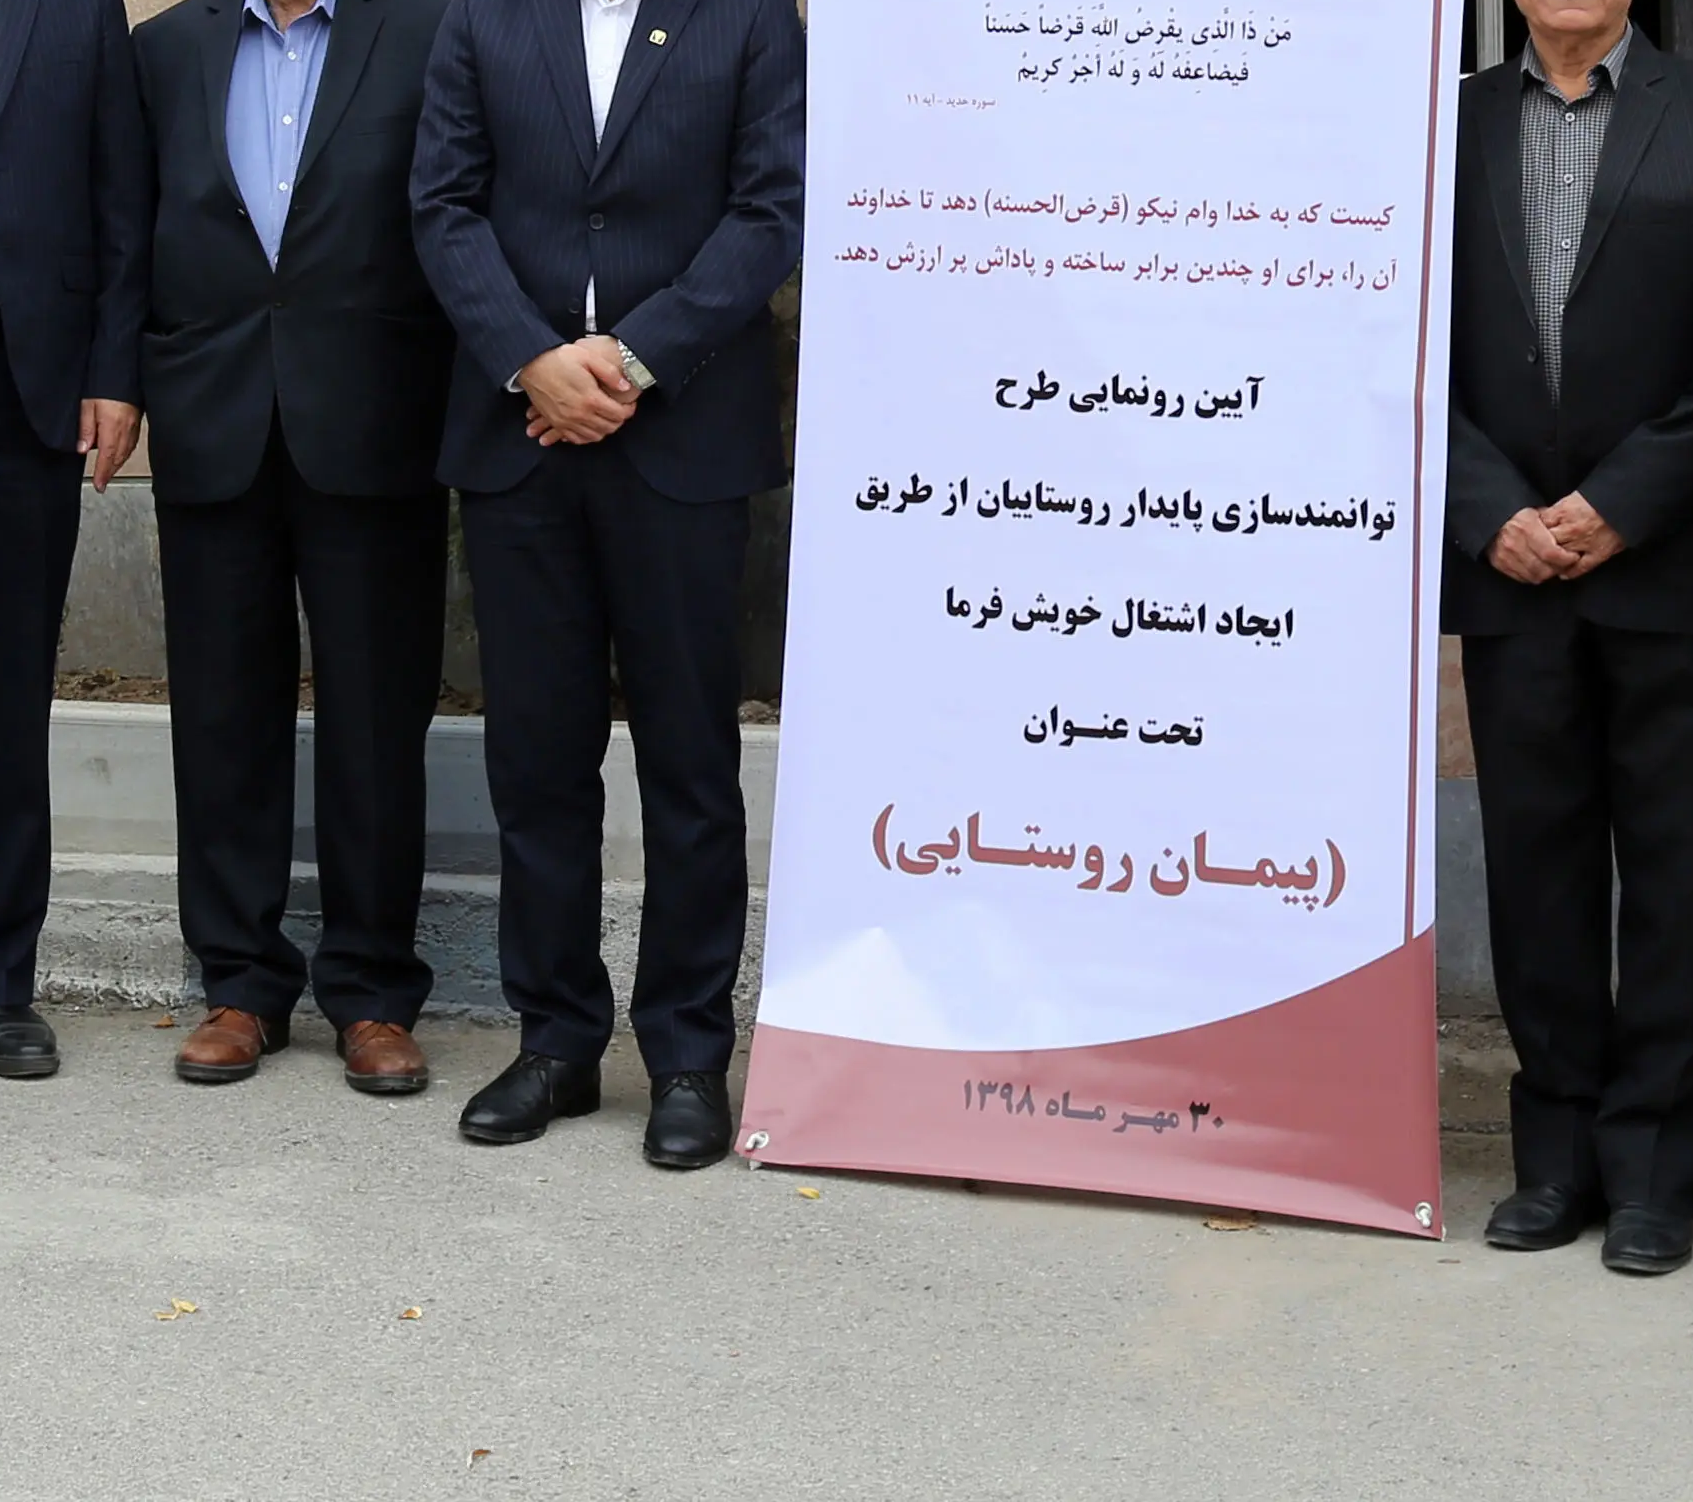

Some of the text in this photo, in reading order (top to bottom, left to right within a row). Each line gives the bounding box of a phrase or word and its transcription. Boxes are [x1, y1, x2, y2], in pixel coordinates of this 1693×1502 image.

[847, 188, 912, 215] خداوند
[919, 189, 935, 209] تا
[941, 194, 978, 212] دهد
[1136, 197, 1178, 225] نیکو
[1226, 199, 1261, 222] خدا
[1297, 202, 1323, 224] که
[1185, 199, 1219, 228] وام
[1269, 211, 1290, 229] به
[1329, 204, 1396, 231] کیست
[833, 245, 880, 263] دهد.
[885, 241, 943, 272] ارزش
[947, 253, 968, 274] پر
[974, 245, 1037, 277] پاداش
[1043, 258, 1056, 278] و
[1062, 250, 1127, 273] ساخته
[1133, 253, 1180, 281] برابر
[1186, 258, 1254, 285] چندین
[1260, 257, 1280, 286] او
[1286, 259, 1335, 287] برای
[1371, 258, 1398, 291] آن
[994, 369, 1266, 421] آیین رونمایی طرح
[854, 474, 1397, 541] توانمندسازی پایدار روستاییان از طریق
[944, 585, 1295, 647] ایجاد اشتغال خویش فرما
[1023, 704, 1204, 747] تحت عنوان
[962, 1077, 1226, 1134] ۳۰ مهر ماه ۱۳۹۸
